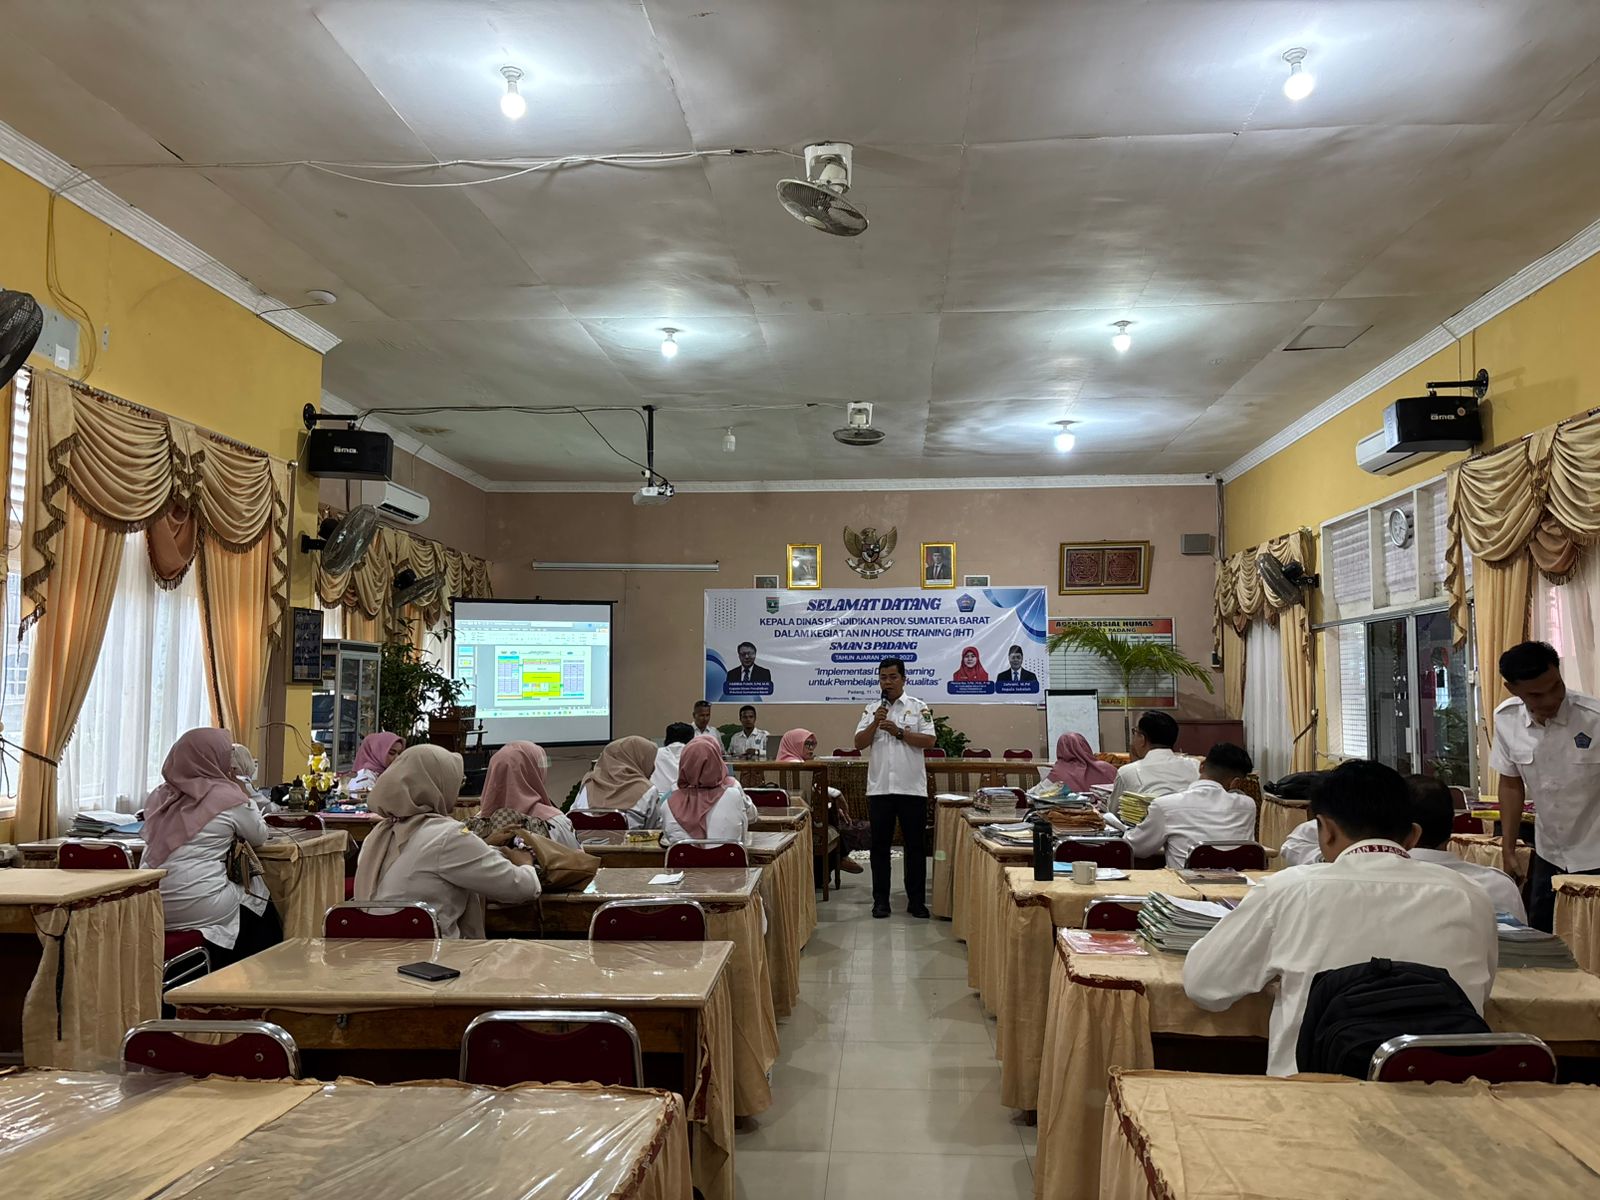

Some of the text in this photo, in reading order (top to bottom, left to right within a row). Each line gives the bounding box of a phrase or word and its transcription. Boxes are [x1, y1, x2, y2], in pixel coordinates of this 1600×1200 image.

[807, 597, 941, 611] SELAMAT DATANG
[760, 616, 990, 626] KEPALA DINAS PENDIDIKAN PROV. SUMATERA BARAT
[774, 629, 809, 638] DALAM
[811, 629, 859, 637] KEGIATAN
[872, 629, 903, 637] HOUSE
[906, 629, 951, 637] TRAINING
[952, 628, 974, 638] (IHT)
[829, 641, 918, 650] SMAN 3 PADANG
[808, 678, 833, 687] untuk
